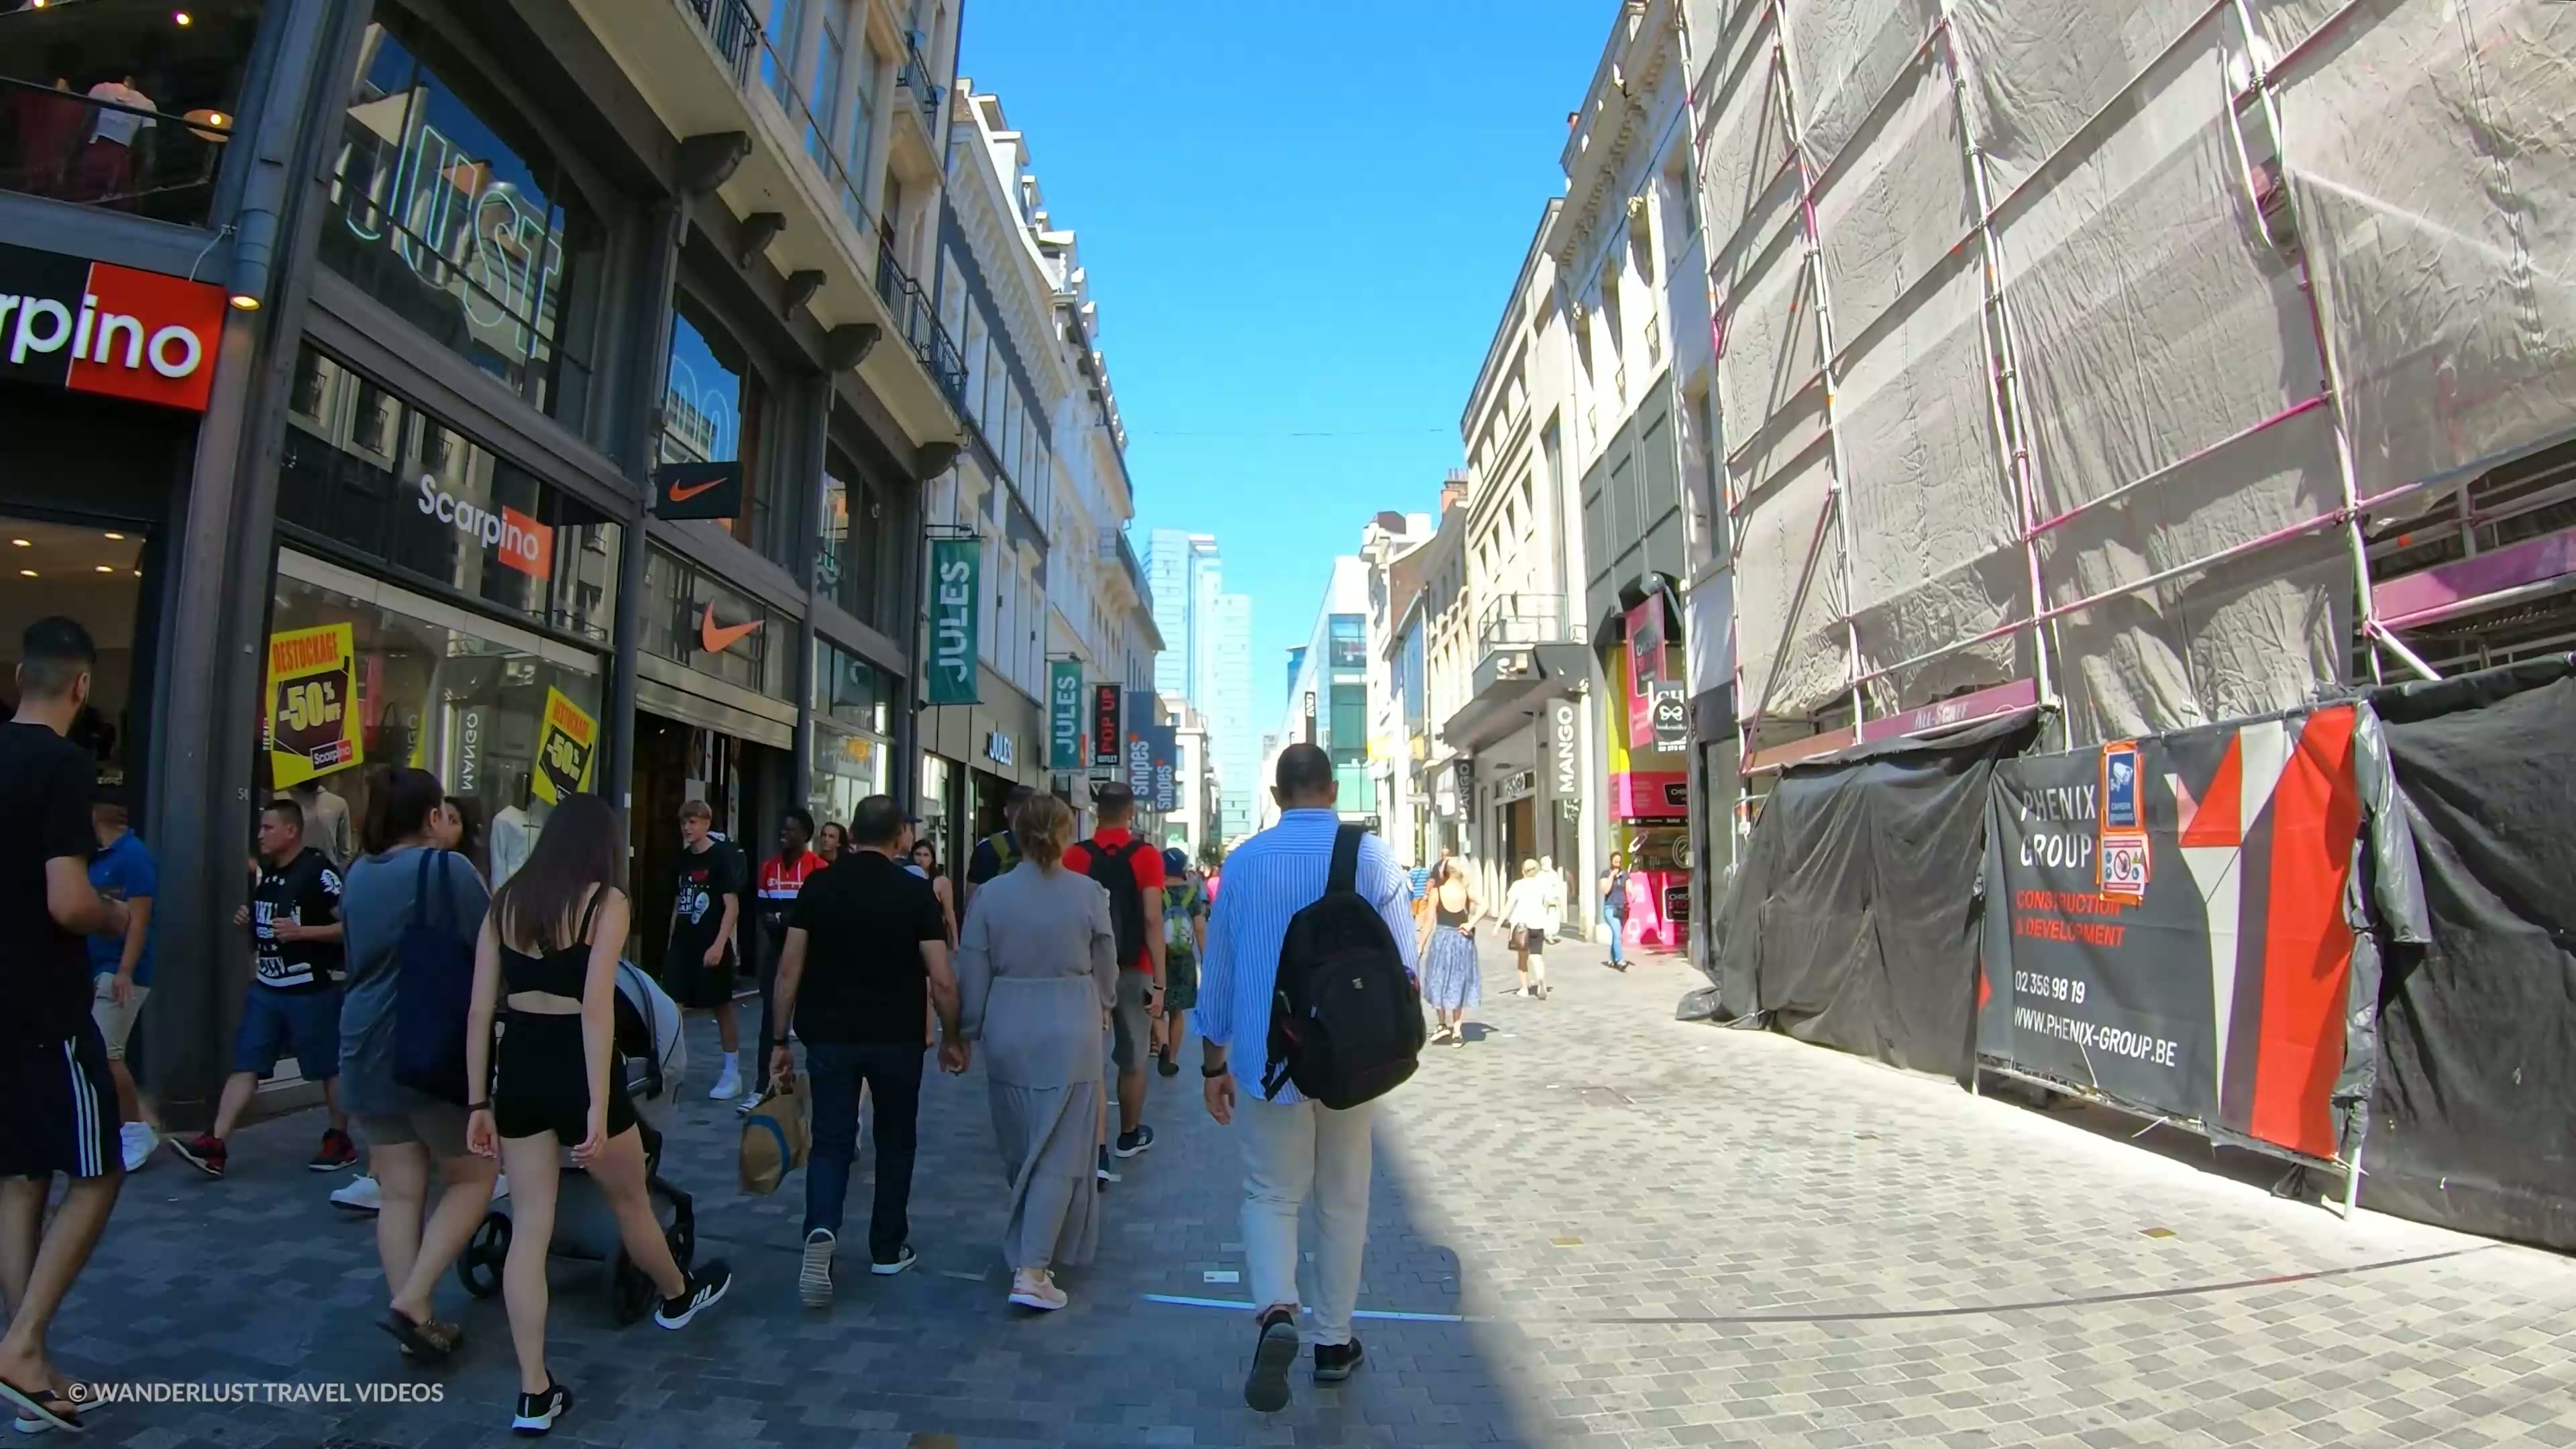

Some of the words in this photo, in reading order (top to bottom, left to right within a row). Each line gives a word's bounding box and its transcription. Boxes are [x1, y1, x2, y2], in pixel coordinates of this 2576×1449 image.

[419, 474, 539, 561] Scarpino
[938, 561, 970, 684] JULES
[272, 632, 339, 674] DESTOCKAGE
[1056, 676, 1077, 755] JULES
[1101, 688, 1116, 711] UP
[1101, 716, 1116, 753] POP
[1556, 705, 1575, 793] MANGO
[1130, 741, 1153, 796] snipes
[1156, 765, 1174, 810] snipes
[2021, 784, 2096, 822] PHENIX
[2020, 834, 2092, 867] GROUP
[2015, 970, 2028, 993] 02
[2030, 973, 2050, 998] 356
[2052, 977, 2069, 1001] 98
[2071, 981, 2086, 1004] 19
[2014, 1006, 2178, 1067] WWW.PHENIX-GROUP.BE
